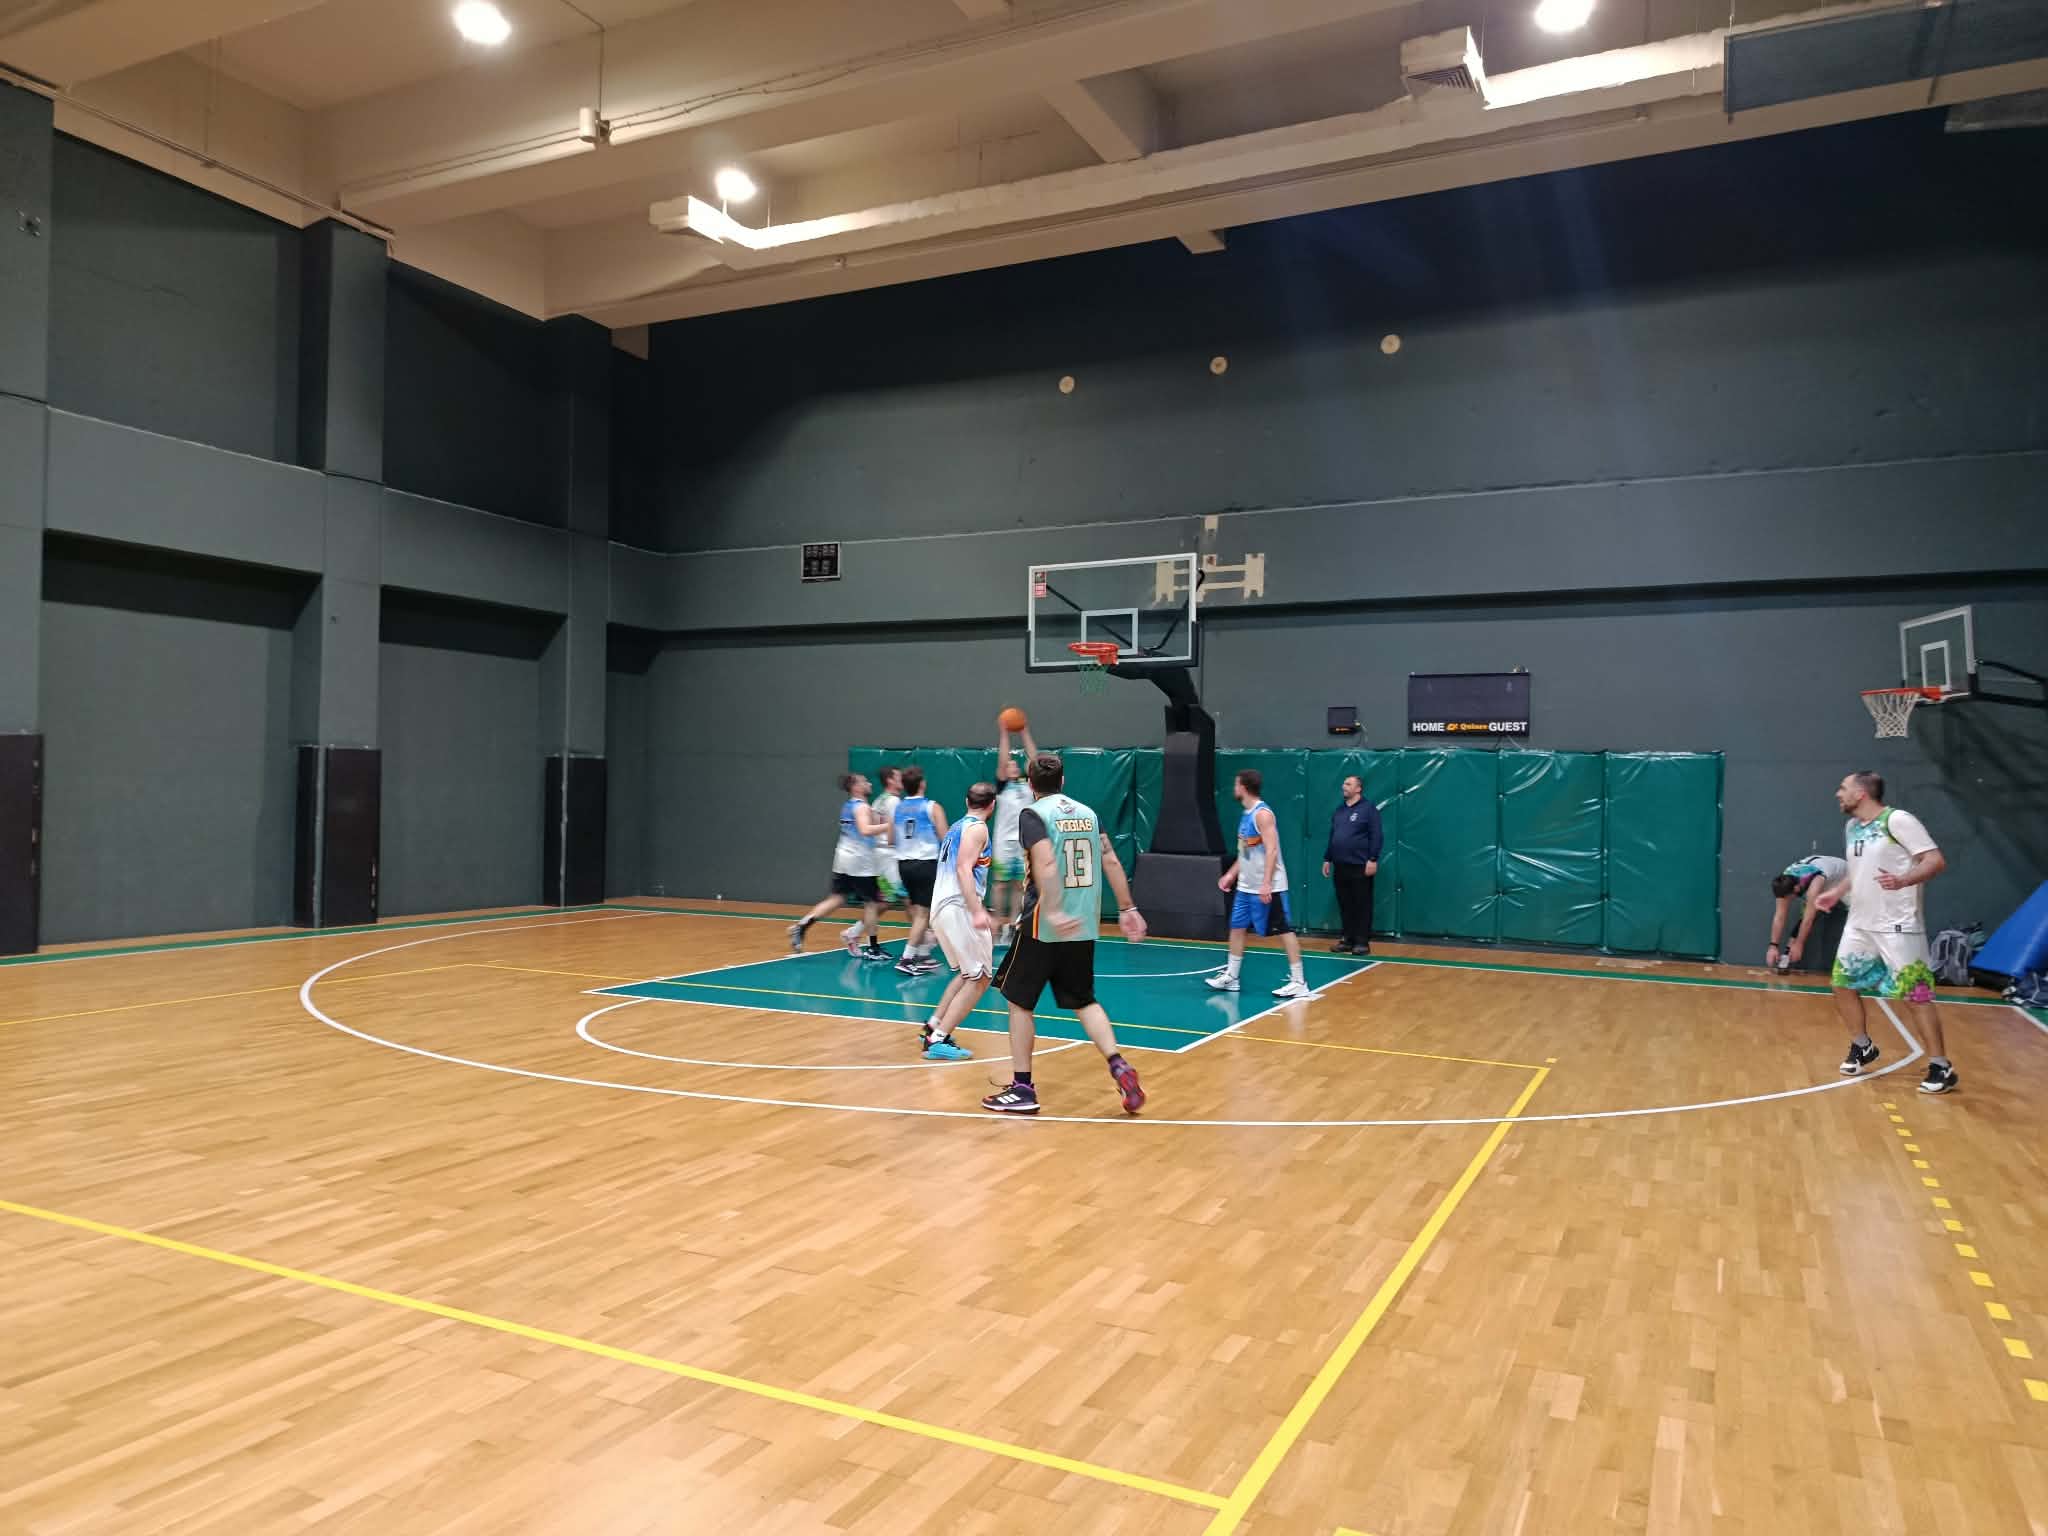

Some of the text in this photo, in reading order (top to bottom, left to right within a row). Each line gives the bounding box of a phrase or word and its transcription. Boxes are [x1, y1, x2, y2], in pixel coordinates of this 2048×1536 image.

[1412, 722, 1445, 732] HOME
[1488, 722, 1527, 732] GUEST
[1063, 838, 1093, 888] 13
